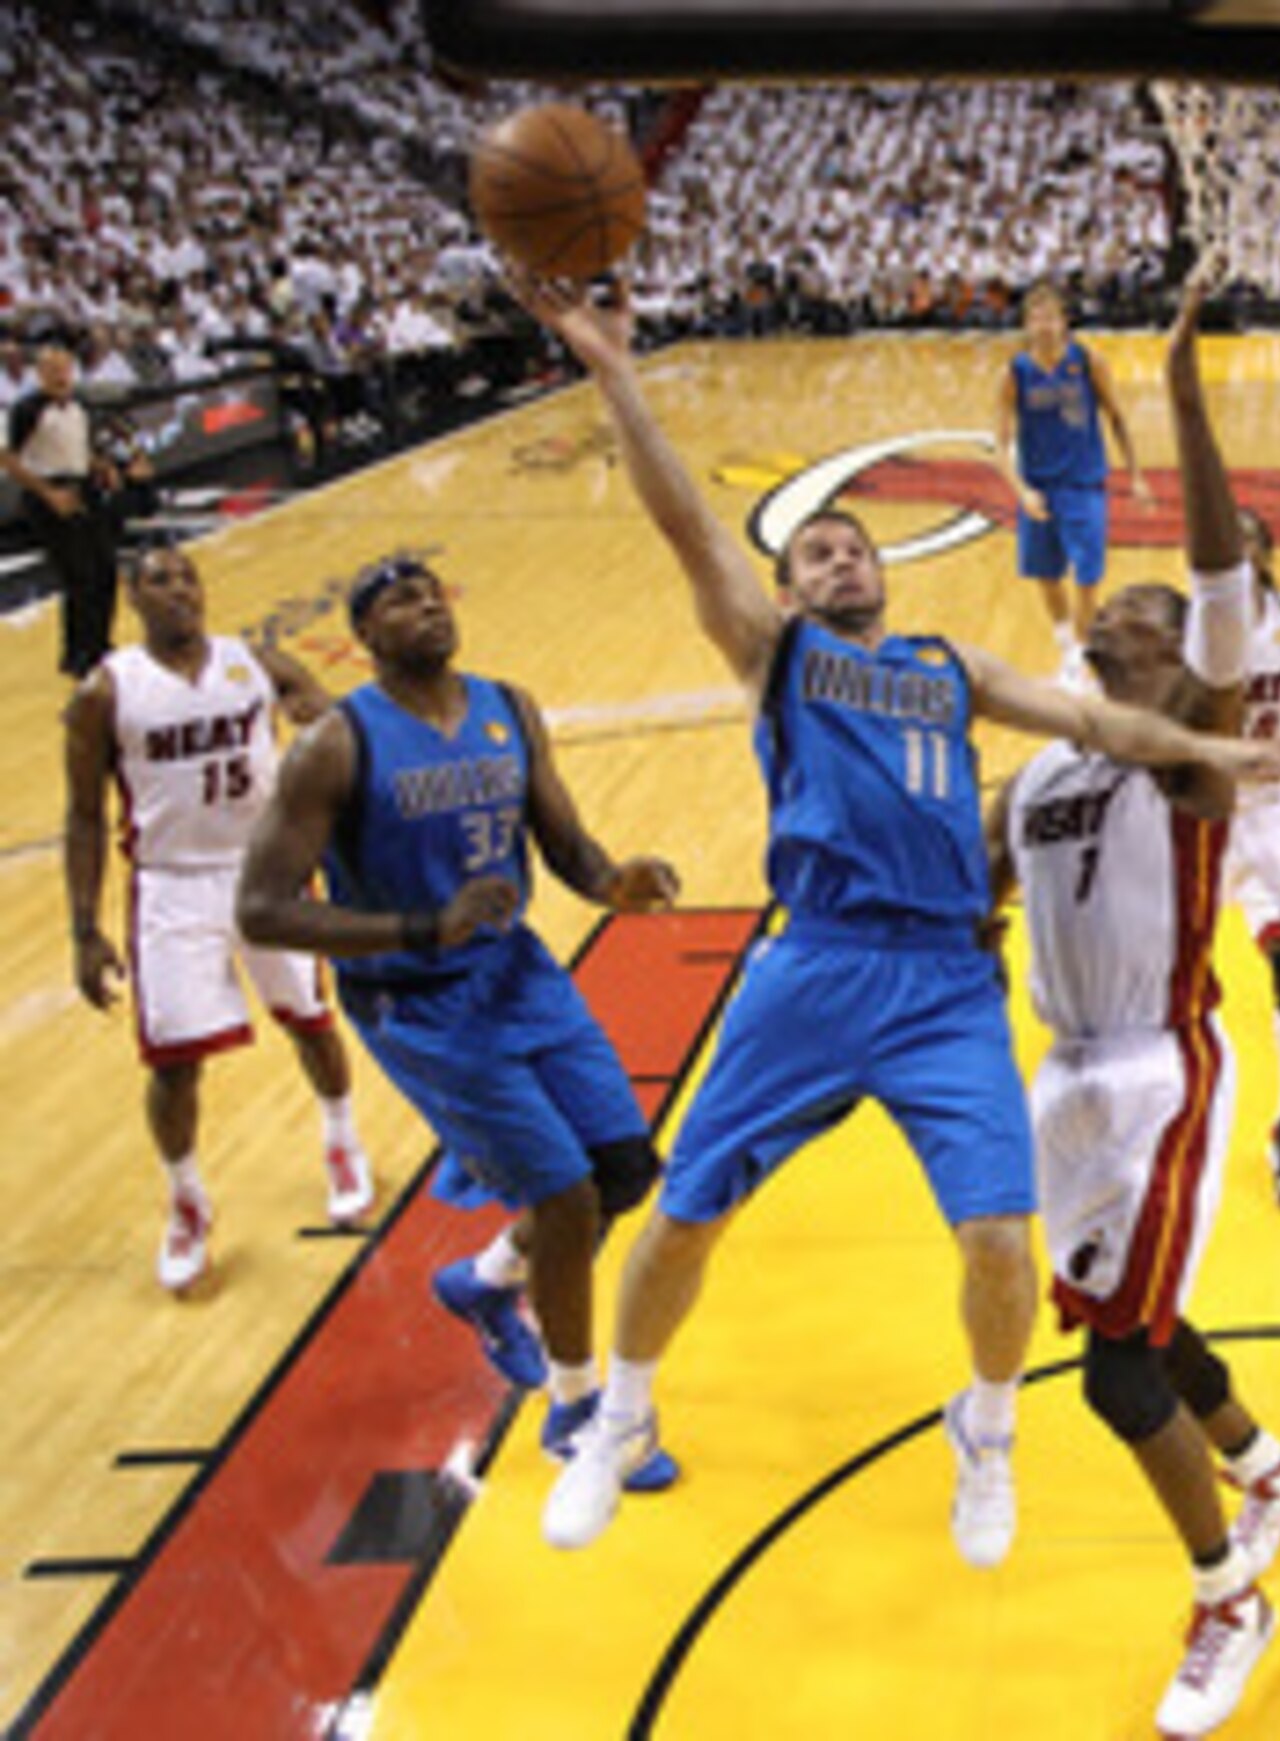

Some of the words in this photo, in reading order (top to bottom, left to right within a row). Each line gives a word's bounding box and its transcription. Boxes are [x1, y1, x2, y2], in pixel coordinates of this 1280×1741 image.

[146, 697, 262, 762] HEAT
[203, 756, 252, 806] 15
[905, 730, 946, 798] 11
[1074, 846, 1099, 905] 1
